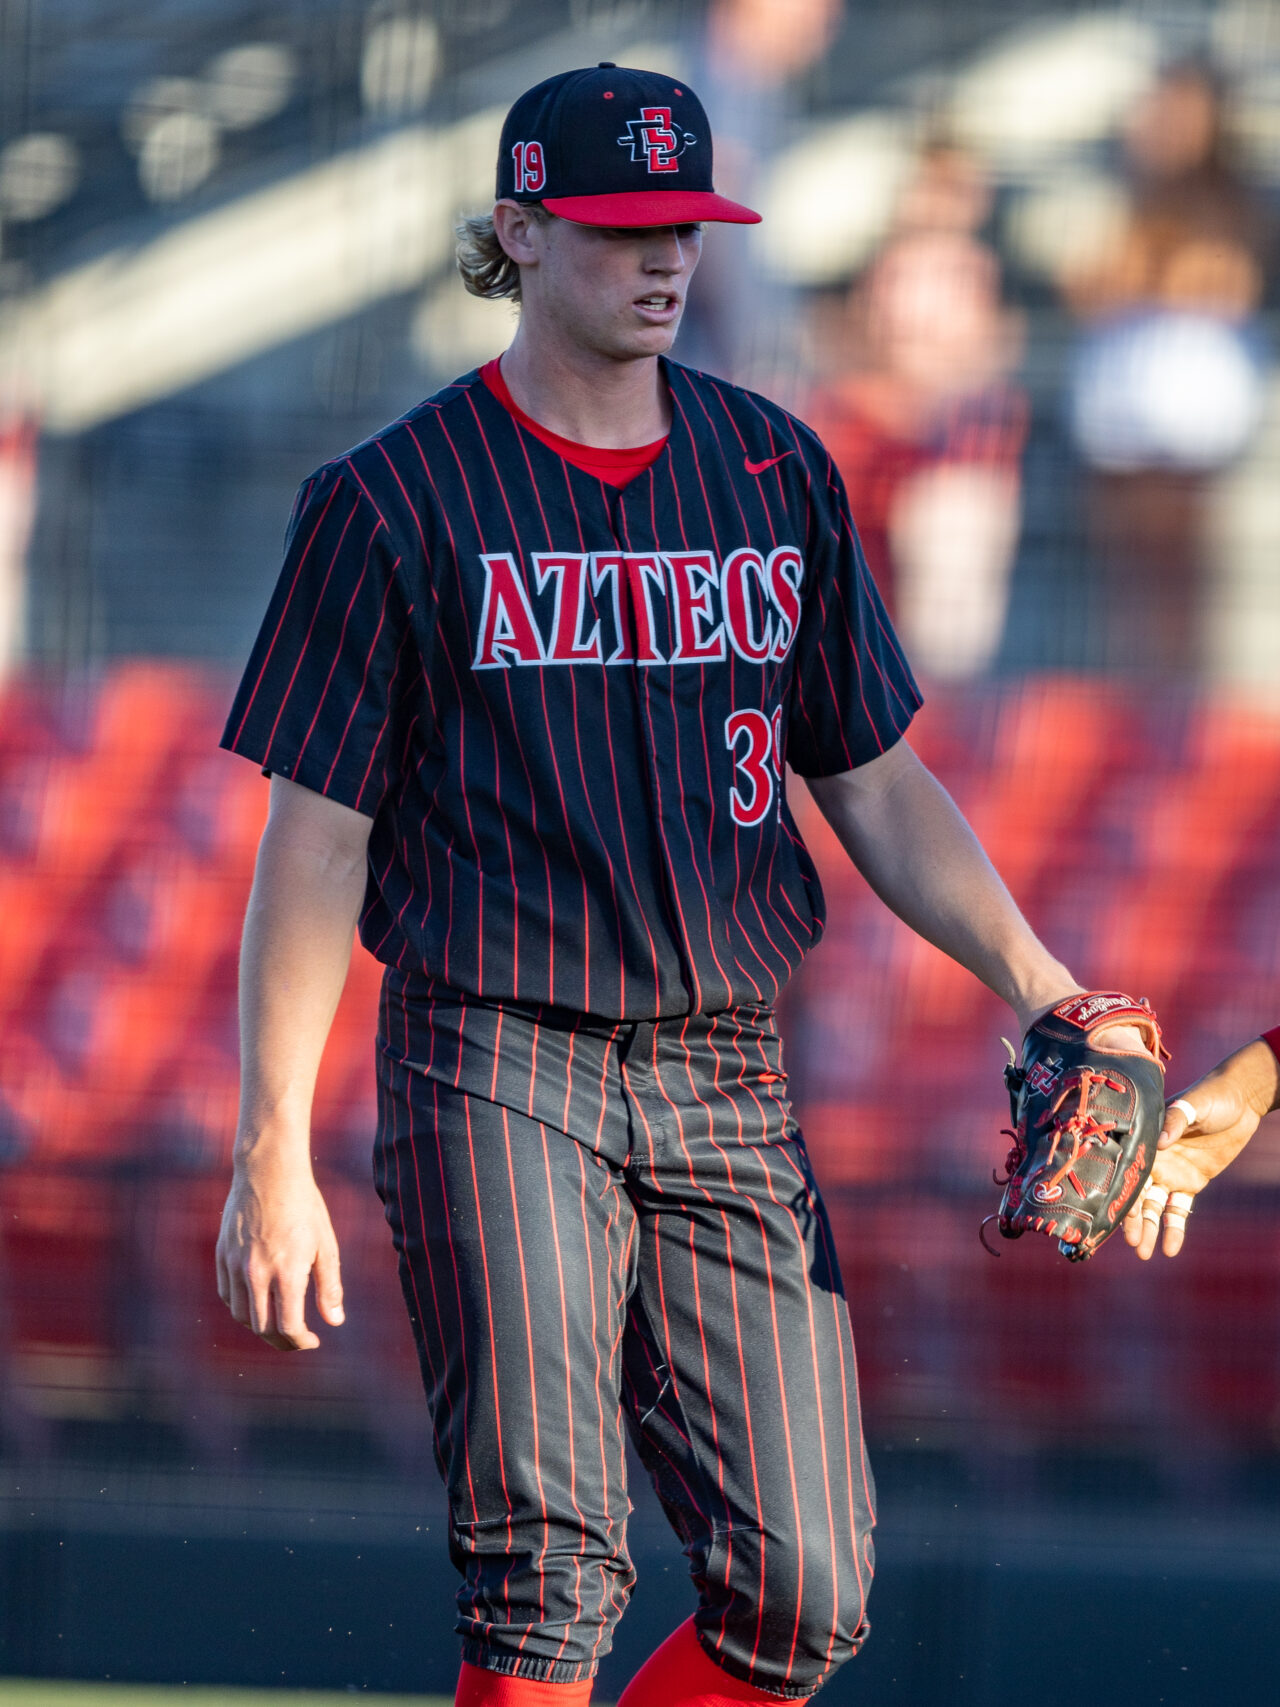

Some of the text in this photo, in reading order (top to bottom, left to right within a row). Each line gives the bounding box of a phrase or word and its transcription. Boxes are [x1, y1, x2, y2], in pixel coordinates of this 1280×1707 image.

[511, 140, 547, 193] 19
[470, 545, 805, 670] AZTECS
[1077, 997, 1132, 1021] Rawlings
[1107, 1143, 1147, 1224] Rawlings
